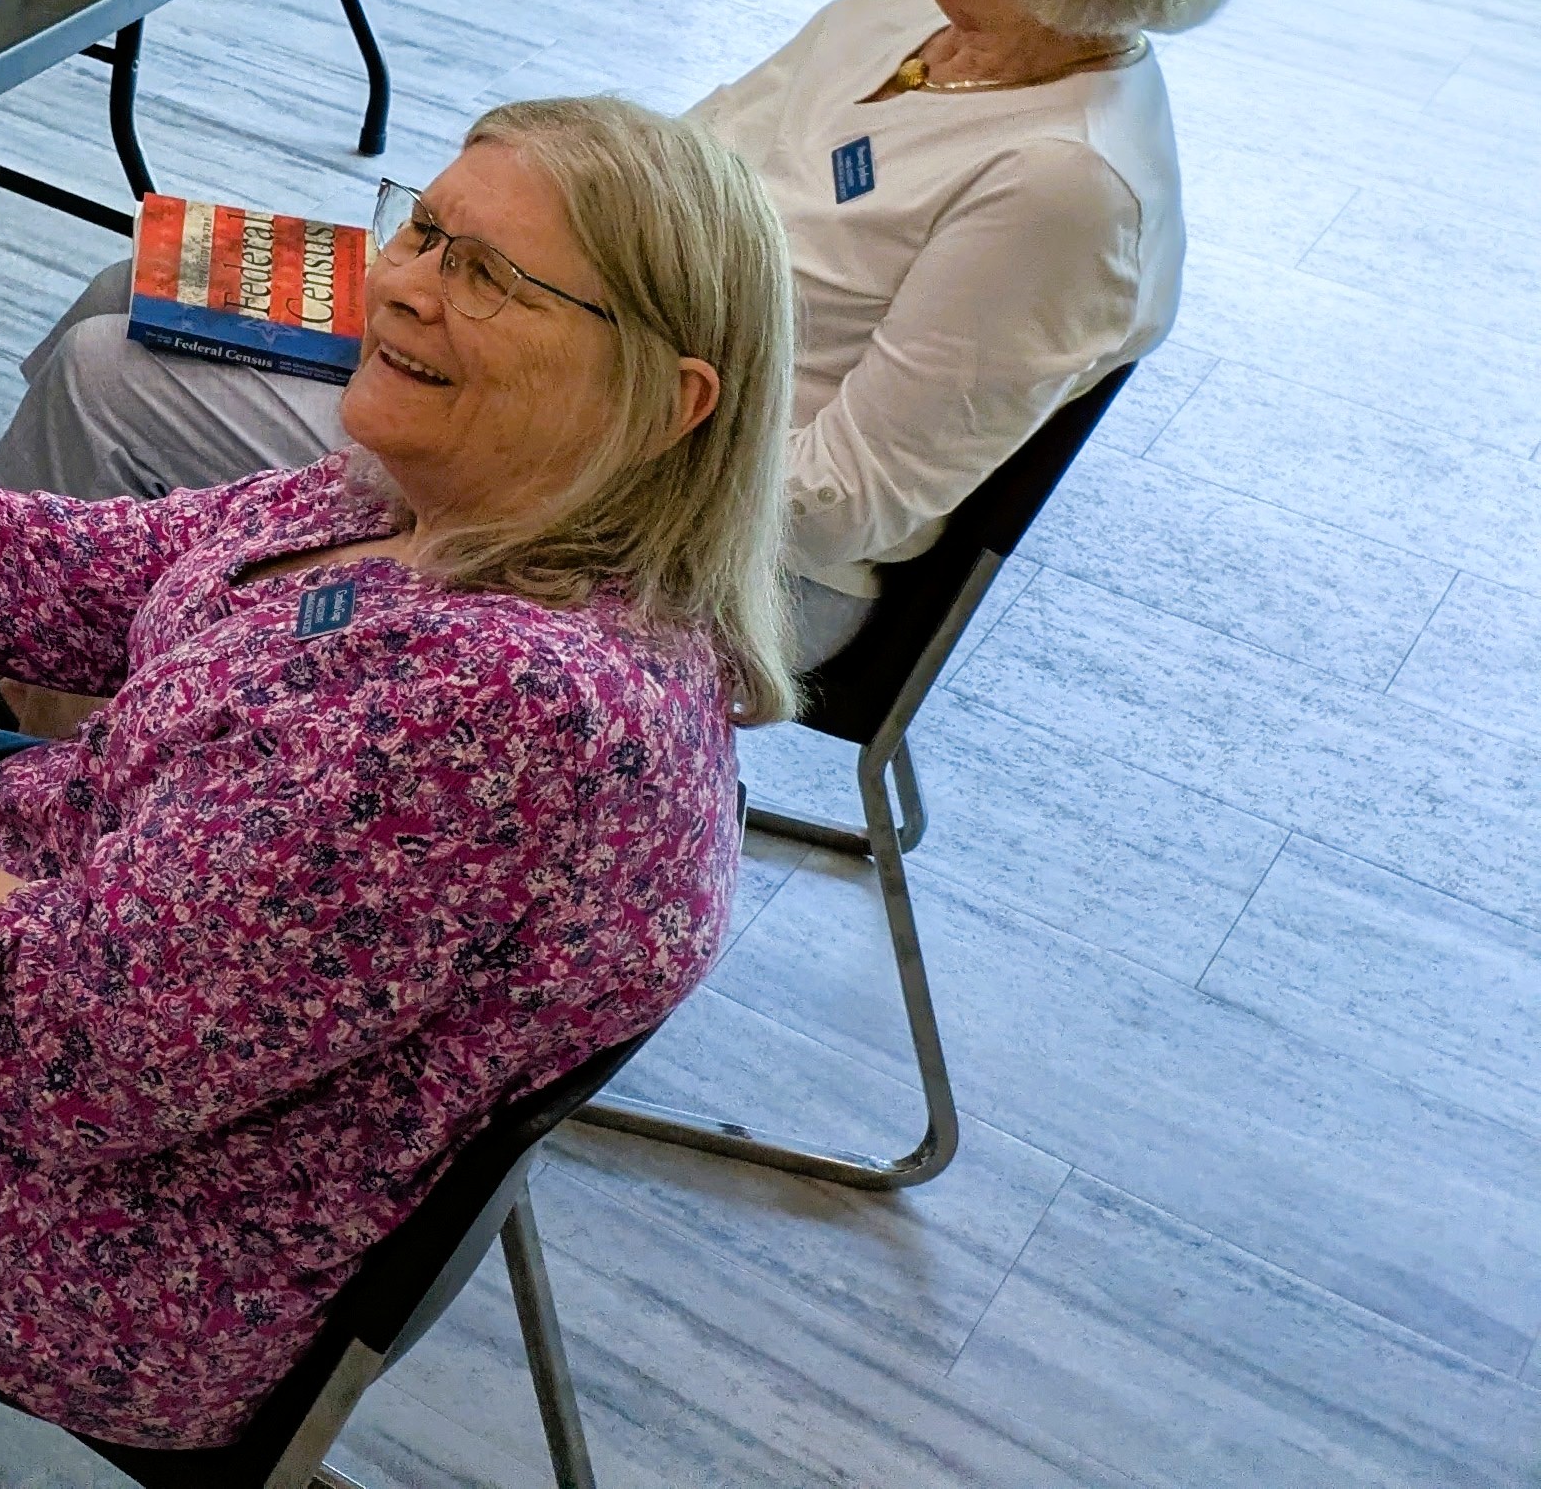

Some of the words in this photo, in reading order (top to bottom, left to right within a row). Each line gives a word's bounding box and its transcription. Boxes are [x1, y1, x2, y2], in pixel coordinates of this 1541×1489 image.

[224, 213, 274, 316] Federal
[286, 224, 335, 324] Census
[174, 337, 223, 358] Federal
[225, 348, 274, 370] Census
